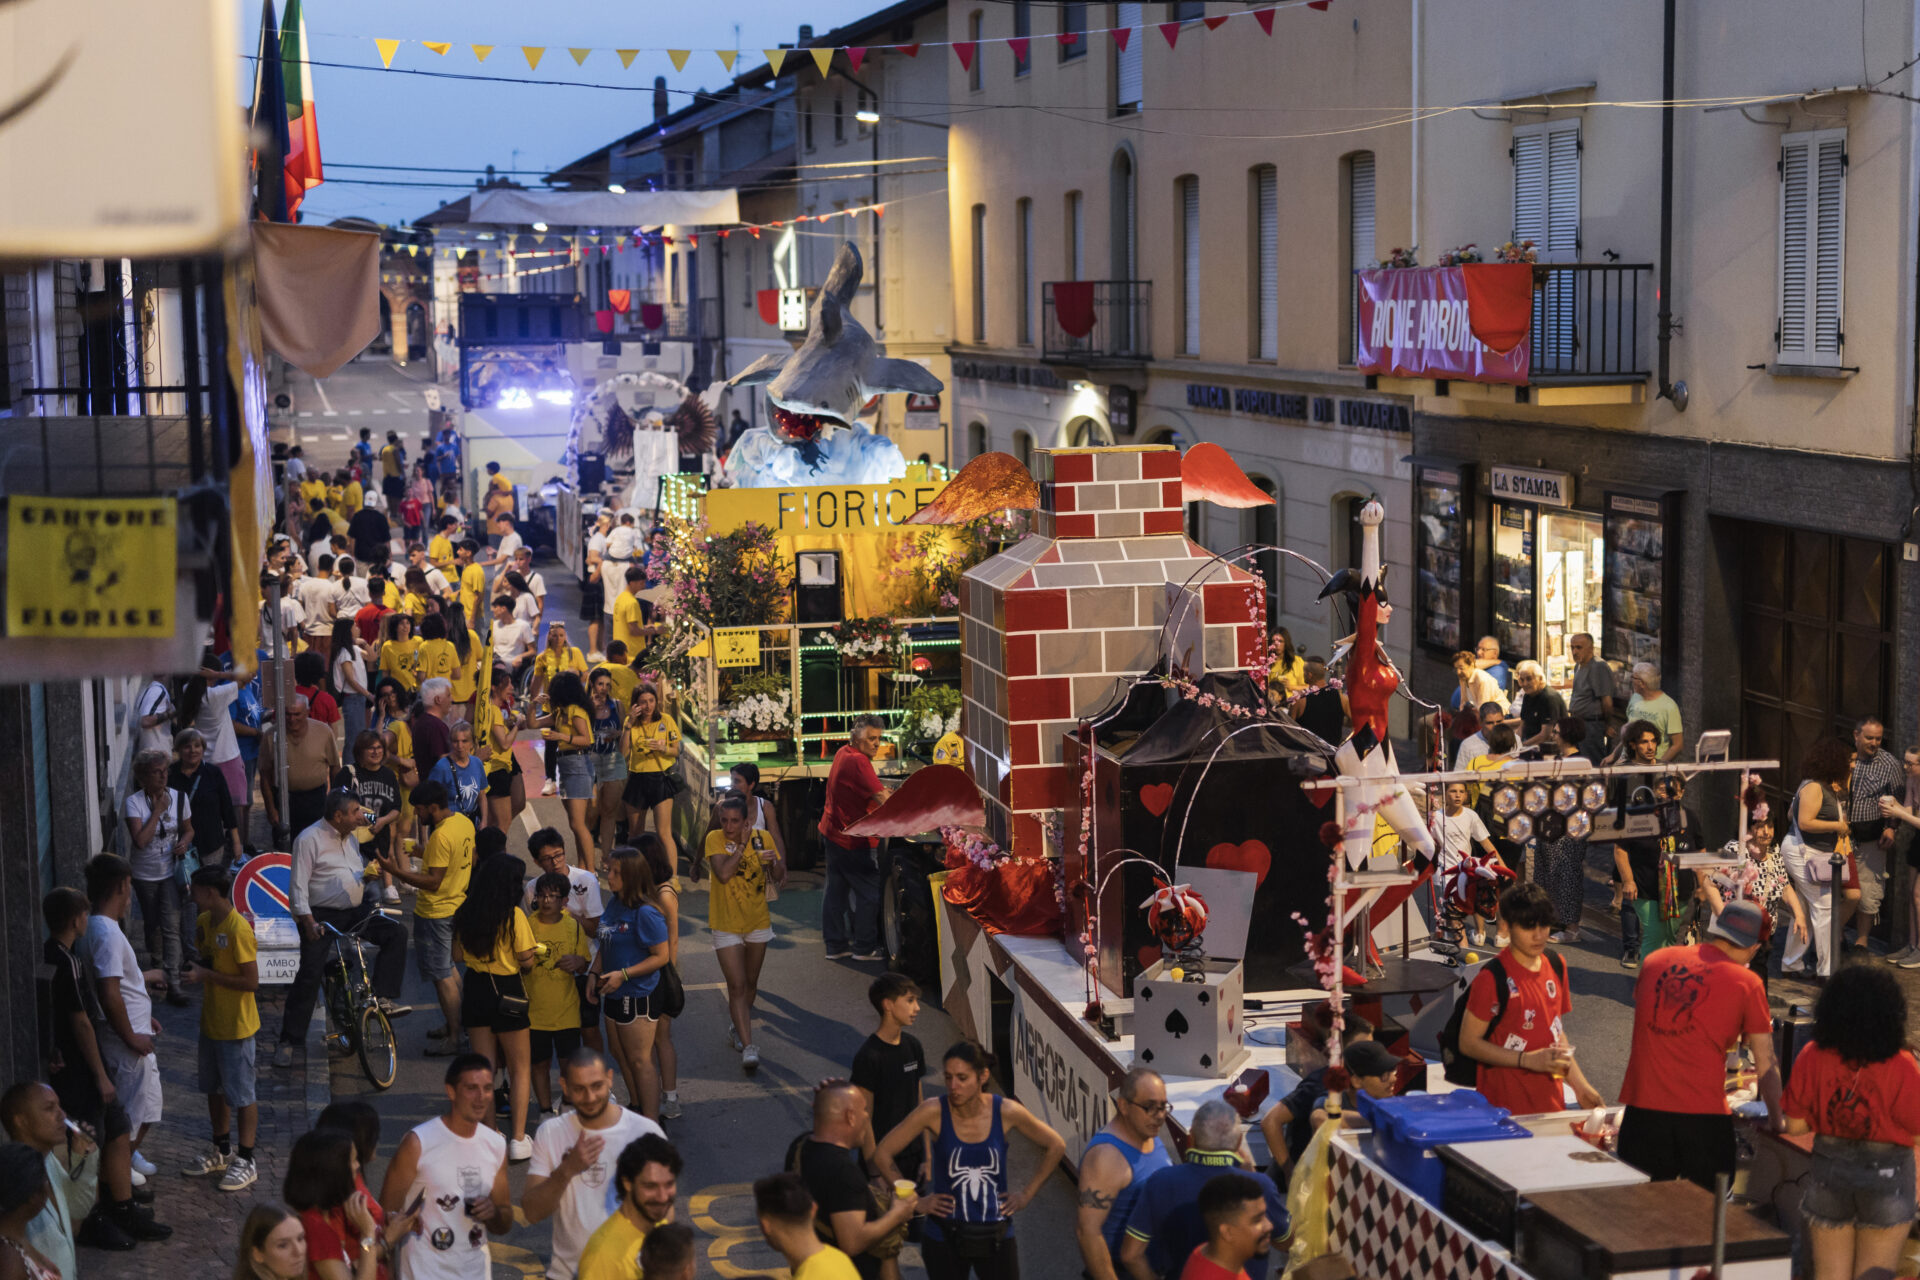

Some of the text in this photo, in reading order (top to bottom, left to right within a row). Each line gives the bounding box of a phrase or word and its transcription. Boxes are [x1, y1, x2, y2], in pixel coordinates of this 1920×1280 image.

[1371, 300, 1416, 348] RIONE
[1186, 385, 1410, 432] BANCA POPOLARE DI NOVARA
[1494, 472, 1560, 498] LA STAMPA
[22, 507, 165, 526] CANTONE
[22, 609, 163, 626] FIORICE
[360, 781, 394, 802] ASHVILLE
[266, 959, 296, 967] AMBO
